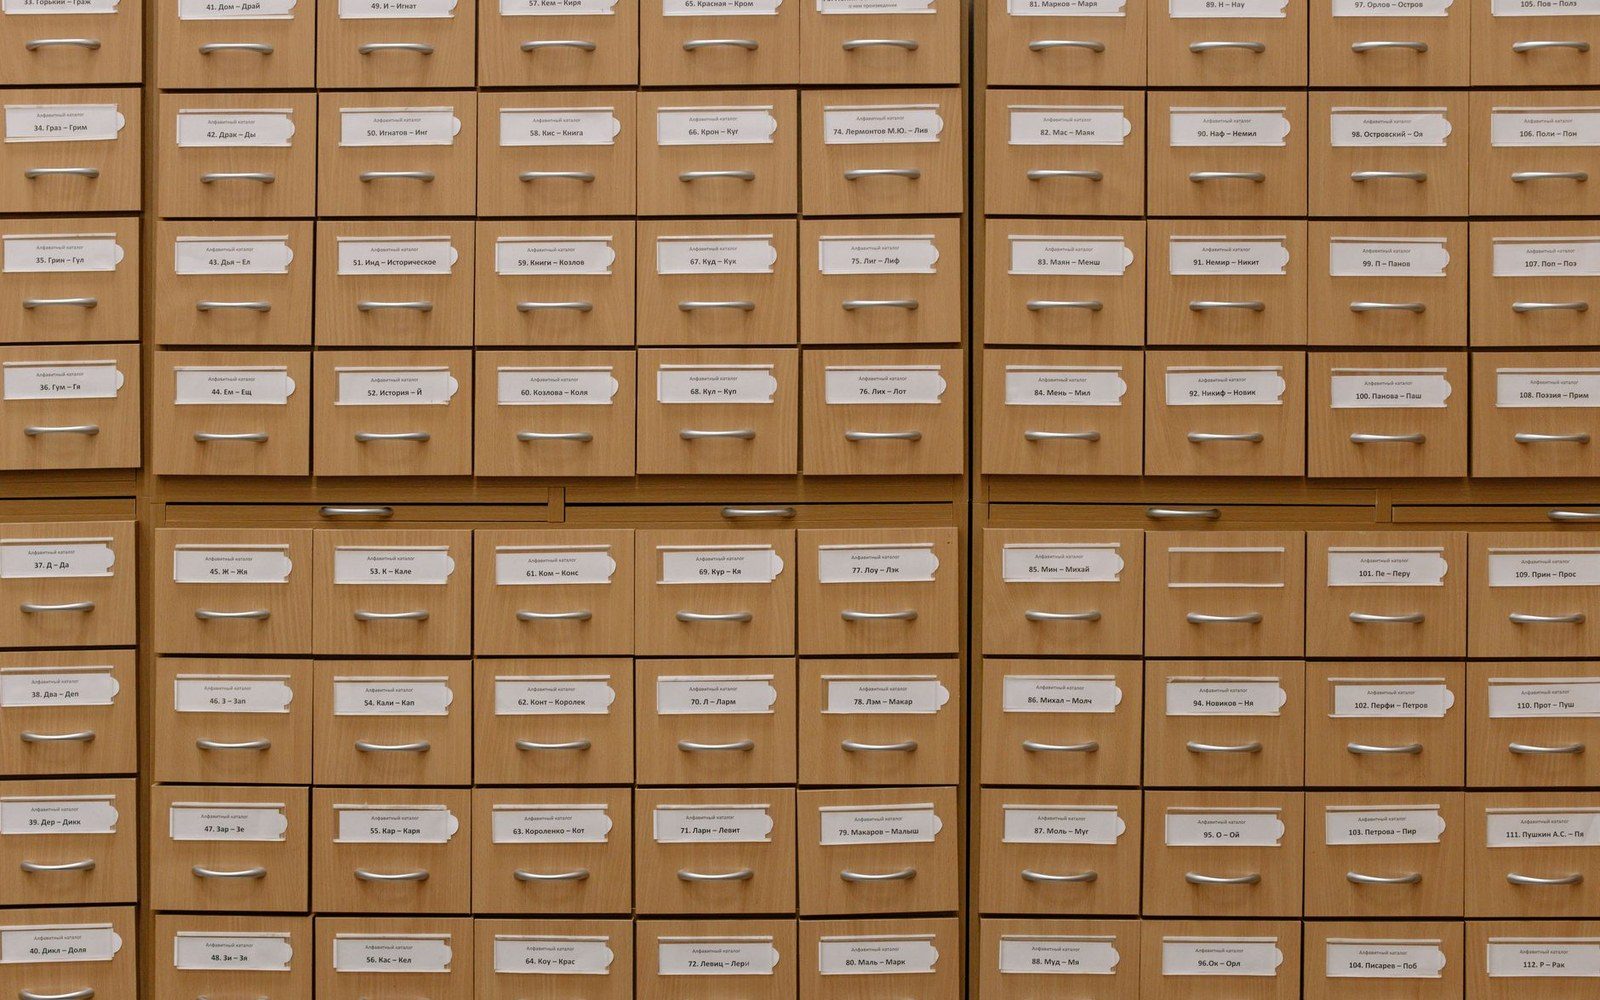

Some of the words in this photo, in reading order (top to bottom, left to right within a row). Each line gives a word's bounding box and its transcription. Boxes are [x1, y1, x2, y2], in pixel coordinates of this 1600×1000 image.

[370, 2, 382, 10] 49.
[396, 2, 417, 10] Игнат
[697, 0, 727, 8] Красная
[734, 0, 754, 8] Кром
[1231, 1, 1245, 9] Нау
[1520, 0, 1536, 8] 105.
[1536, 0, 1552, 8] Пов
[34, 124, 45, 132] 34.
[46, 124, 62, 133] Граз
[69, 124, 88, 132] Грим
[845, 128, 886, 136] Лермонтов
[529, 129, 541, 137] 58.
[1363, 130, 1406, 139] Островский
[1413, 130, 1424, 138] Оя
[208, 258, 220, 266] 43.
[220, 258, 235, 267] Дья
[241, 258, 251, 266] Ел
[364, 259, 381, 267] Инд
[387, 259, 437, 267] Историческое
[518, 259, 529, 267] 59.
[1037, 258, 1049, 266] 83.
[223, 388, 234, 396] Ем
[241, 388, 253, 396] Ещ
[702, 388, 716, 396] Кул
[723, 388, 737, 396] Куп
[1034, 389, 1046, 397] 84.
[1046, 389, 1067, 397] Мень
[1519, 391, 1534, 399] 108.
[1535, 391, 1562, 399] Поэзия
[1568, 392, 1589, 400] Прим
[369, 567, 381, 575] 53.
[698, 568, 710, 576] 69.
[711, 568, 725, 576] Кур
[1515, 571, 1530, 579] 109.
[1531, 571, 1551, 579] Прин
[1558, 570, 1577, 579] Прос
[43, 691, 58, 699] Два
[64, 690, 79, 699] Деп
[363, 699, 375, 707] 54.
[376, 699, 394, 707] Кали
[853, 698, 865, 706] 78.
[865, 698, 882, 706] Лэм
[888, 698, 913, 706] Макар
[1193, 699, 1204, 707] 94.
[29, 818, 40, 826] 39.
[40, 818, 56, 827] Дер
[62, 818, 81, 827] Дикк
[524, 828, 565, 836] Короленко
[850, 829, 884, 837] Макаров
[1364, 828, 1395, 836] Петрова
[1402, 828, 1417, 836] Пир
[210, 954, 222, 962] 48.
[223, 954, 233, 962] Зи
[239, 954, 248, 962] Зя
[525, 957, 536, 965] 64.
[537, 958, 552, 966] Коу
[558, 958, 576, 966] Крас
[1044, 958, 1061, 966] Муд
[1349, 961, 1364, 969] 104.
[1365, 962, 1396, 970] Писарев
[1402, 962, 1418, 970] Поб
